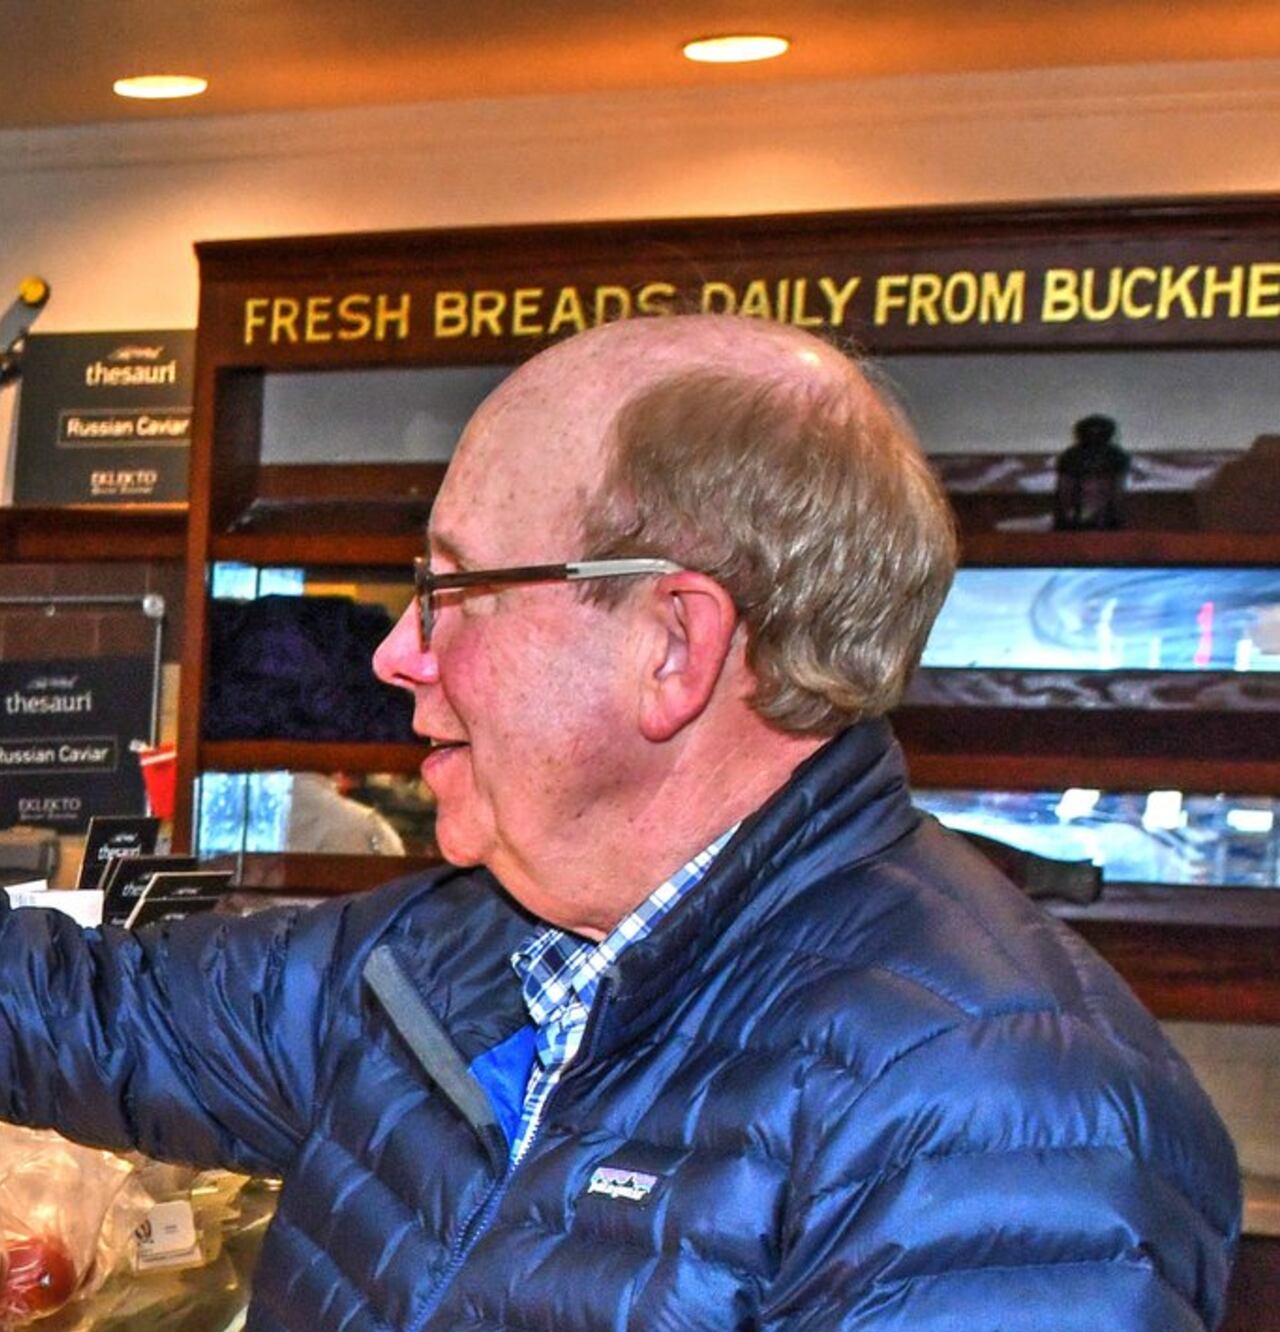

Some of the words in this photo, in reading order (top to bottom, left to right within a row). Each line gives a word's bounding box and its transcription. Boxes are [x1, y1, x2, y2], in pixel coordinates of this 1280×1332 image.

[244, 294, 411, 346] FRESH
[434, 282, 677, 338] BREADS
[701, 277, 861, 328] DAILY
[874, 270, 1026, 326] FROM
[1041, 263, 1280, 323] BUCKHE
[85, 360, 177, 387] thesauri
[66, 417, 134, 438] Russian
[136, 415, 190, 437] Caviar
[5, 690, 93, 715] thesauri
[58, 744, 109, 764] Caviar
